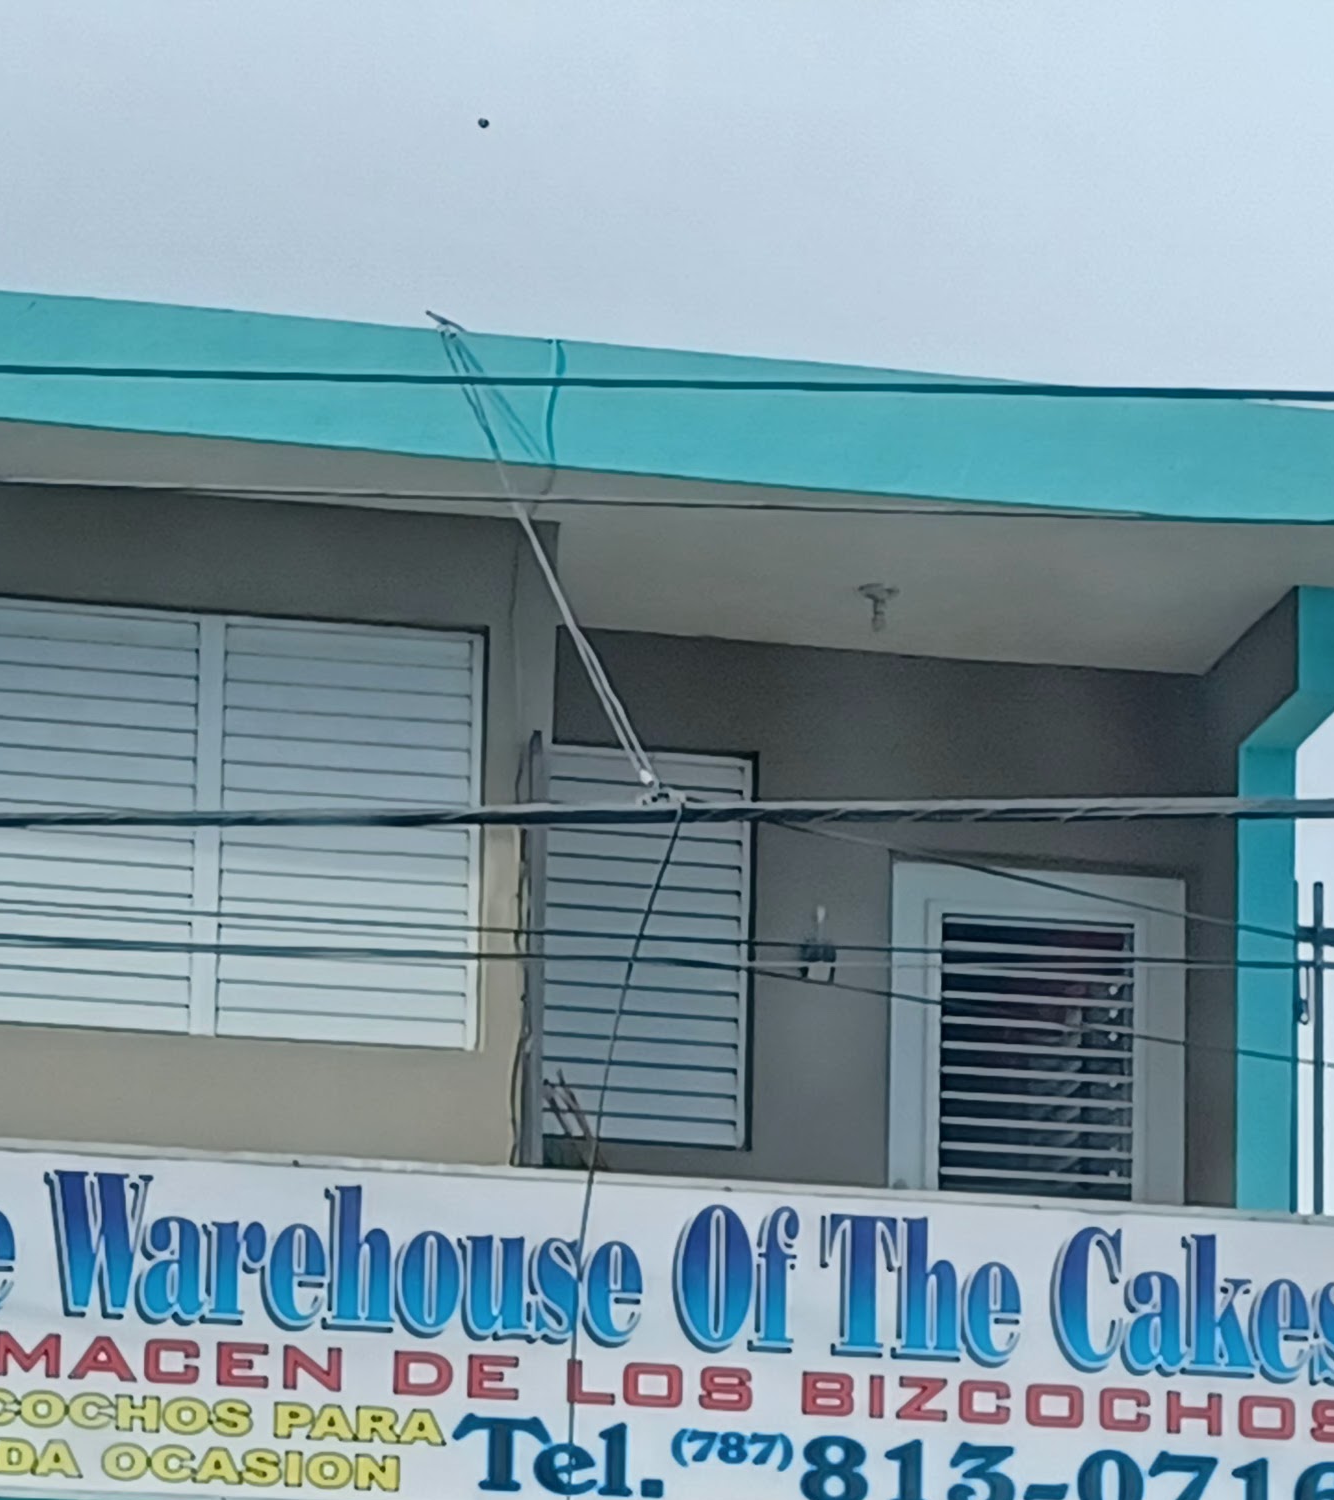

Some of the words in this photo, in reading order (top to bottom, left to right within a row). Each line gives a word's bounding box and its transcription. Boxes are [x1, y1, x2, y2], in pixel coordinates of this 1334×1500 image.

[43, 1168, 643, 1348] Warehouse
[672, 1203, 801, 1354] Of
[820, 1212, 1022, 1368] The
[393, 1350, 520, 1401] DE
[566, 1359, 753, 1412] LOS
[272, 1400, 446, 1447] PARA
[101, 1443, 401, 1493] OCASION
[453, 1415, 665, 1498] Tel.
[670, 1426, 795, 1473] (787)
